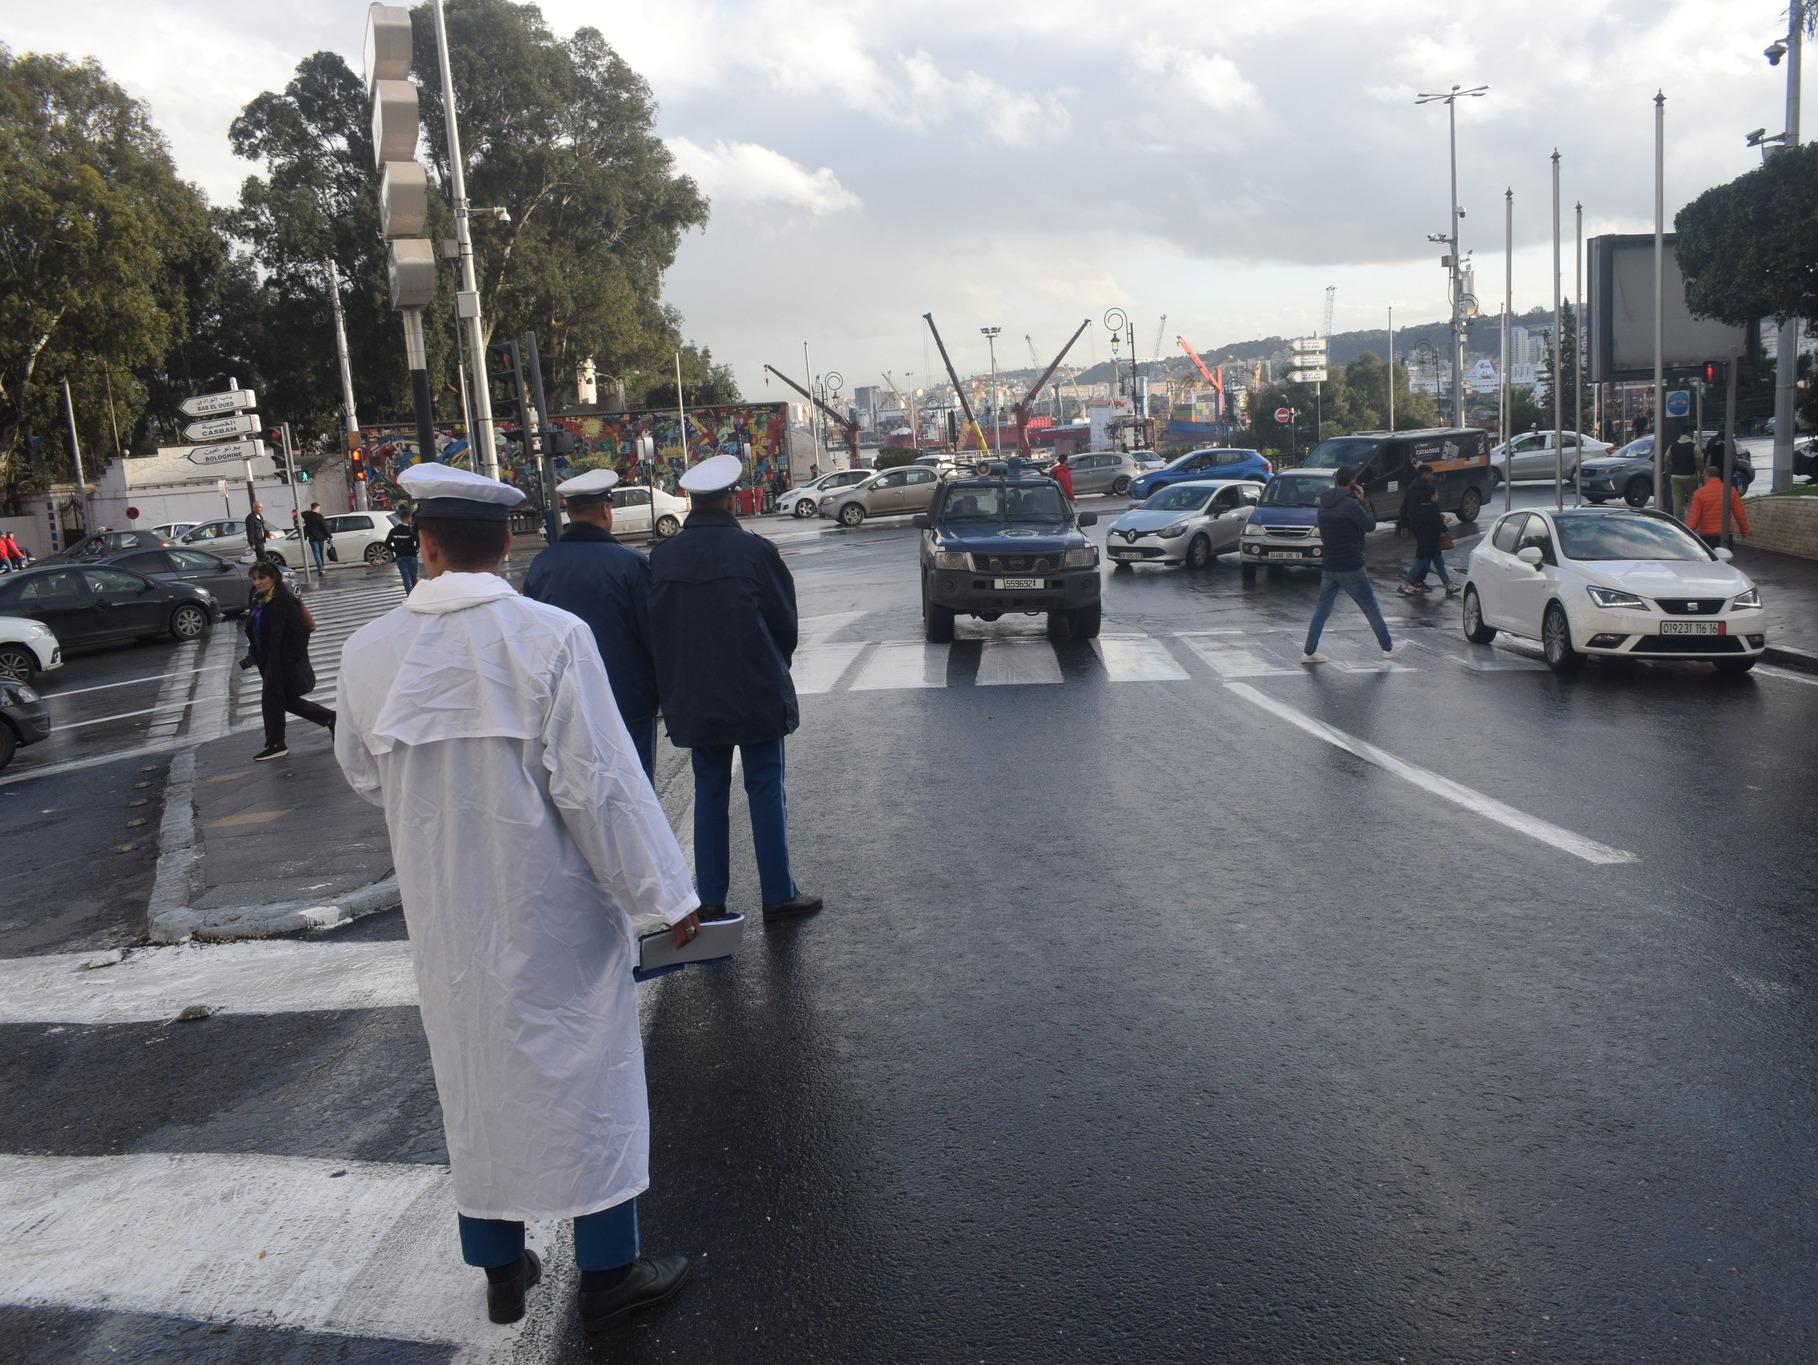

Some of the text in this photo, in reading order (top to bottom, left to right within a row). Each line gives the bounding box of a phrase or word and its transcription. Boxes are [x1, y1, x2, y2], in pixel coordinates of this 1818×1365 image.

[202, 427, 236, 436] CASBAH
[1415, 447, 1440, 455] CATALOGUE
[205, 452, 242, 461] BOLOGHINE
[1663, 623, 1718, 634] 019231 116 16
